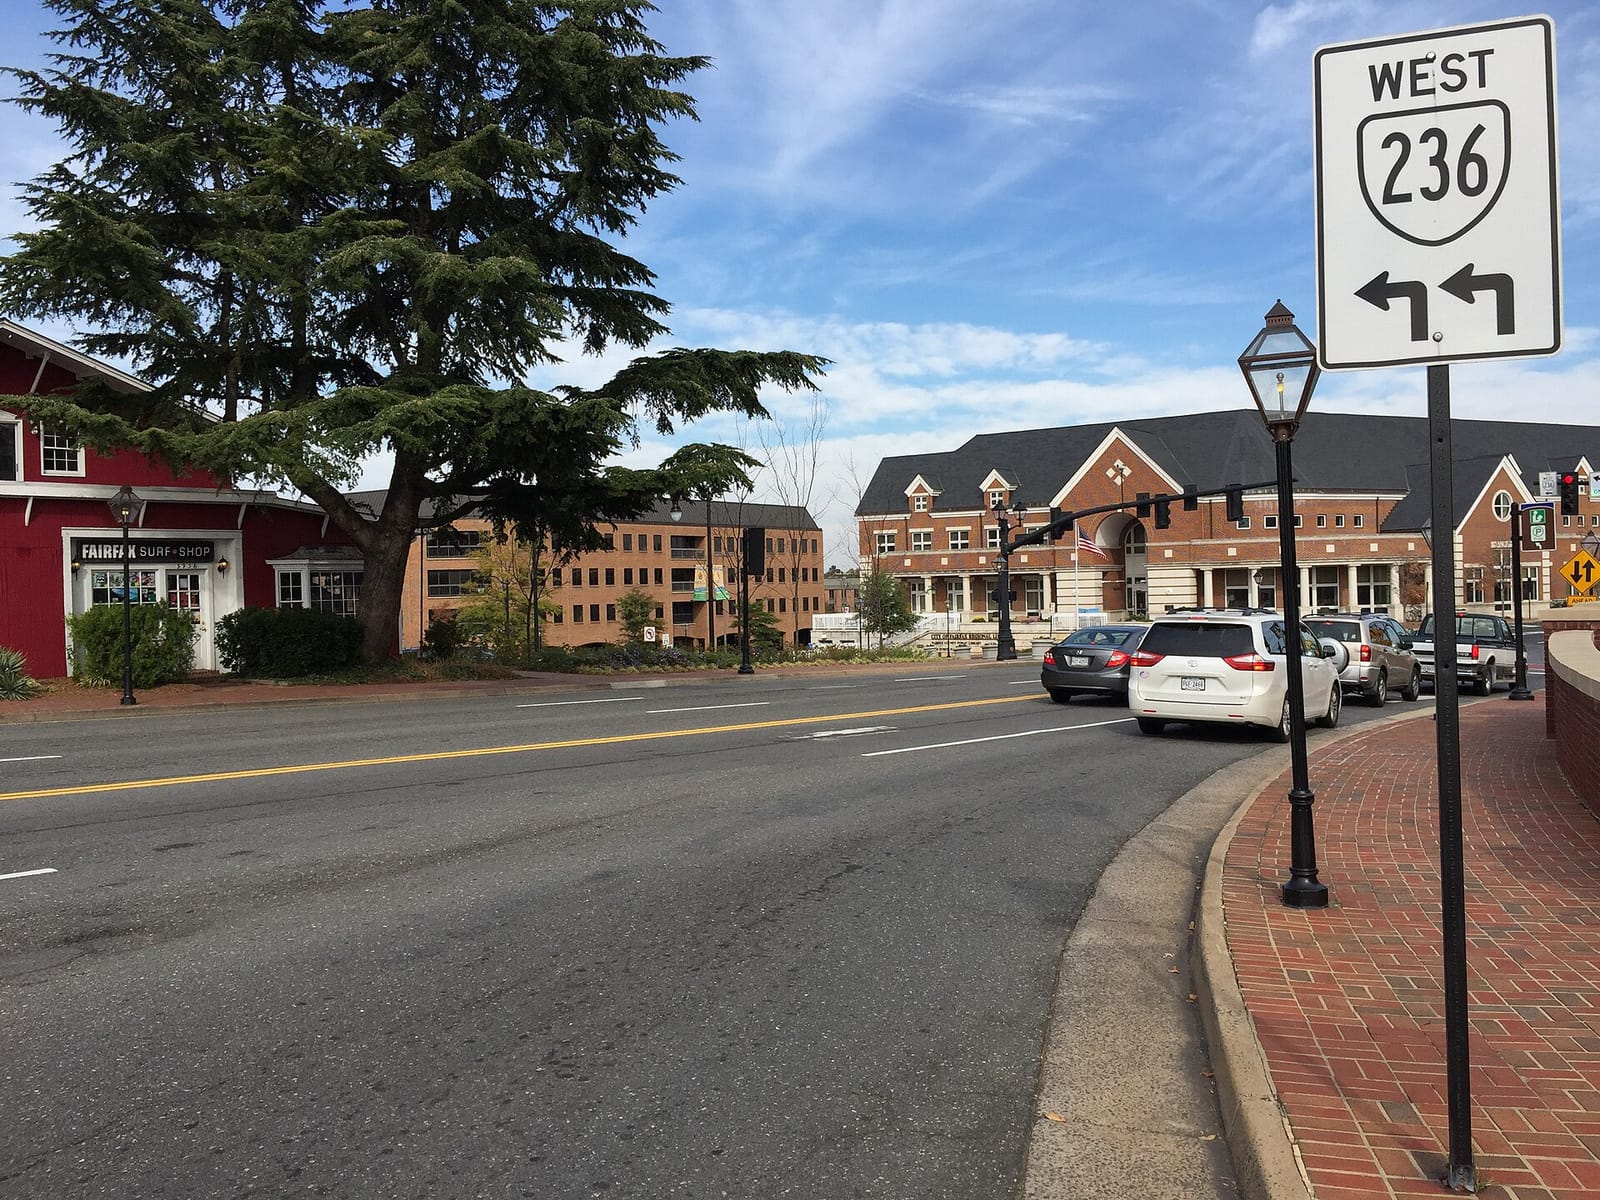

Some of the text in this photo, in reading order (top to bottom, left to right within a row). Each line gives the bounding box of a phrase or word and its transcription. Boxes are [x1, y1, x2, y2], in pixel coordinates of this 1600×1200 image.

[1368, 48, 1494, 102] WEST
[1380, 123, 1488, 205] 236
[140, 546, 171, 557] SURF
[179, 546, 210, 557] SHOP
